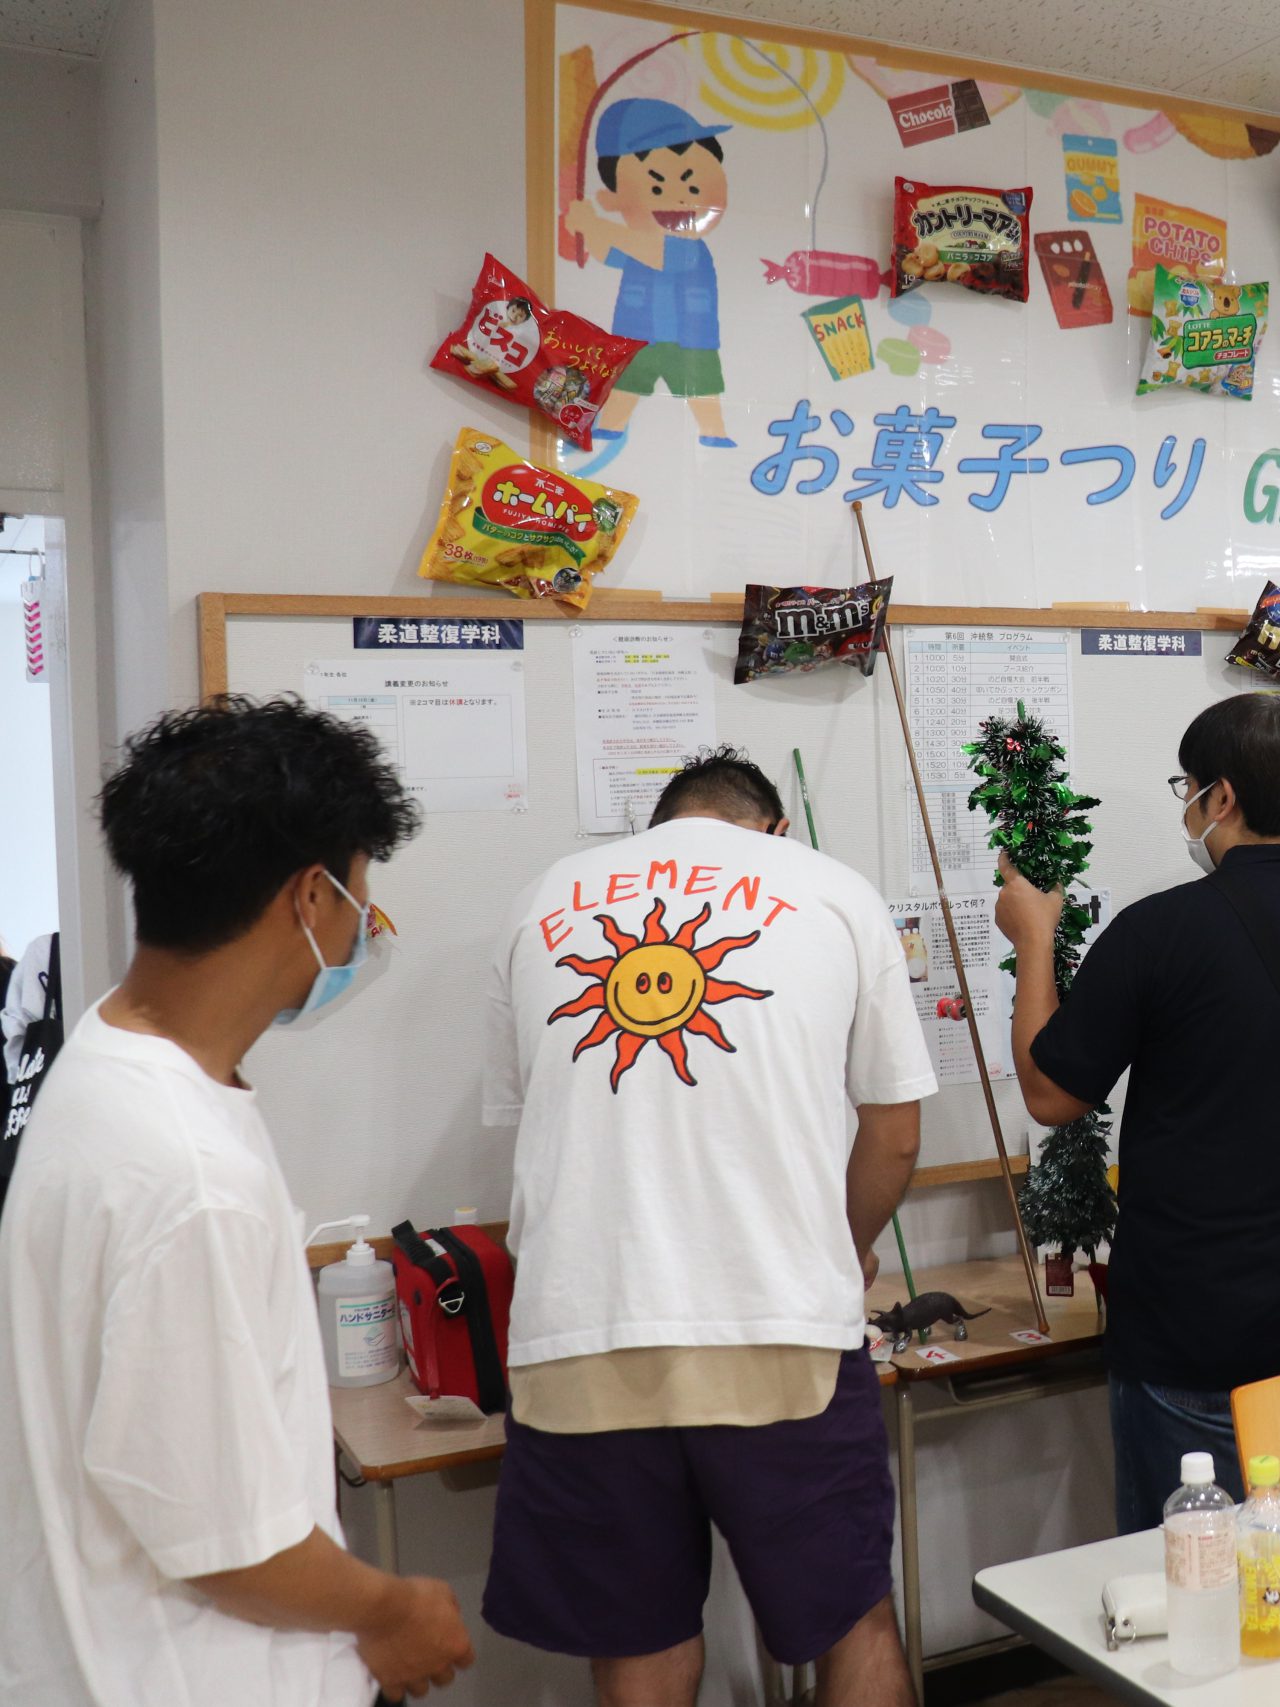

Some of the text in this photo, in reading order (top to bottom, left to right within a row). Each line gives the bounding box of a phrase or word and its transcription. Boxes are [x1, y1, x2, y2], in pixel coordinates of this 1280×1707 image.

[899, 102, 953, 128] Chocola
[1066, 157, 1117, 174] GUMMY
[1144, 216, 1221, 252] POTATO
[974, 253, 993, 262] ココア
[1149, 236, 1213, 266] CHIPS
[478, 307, 529, 368] ビスコ
[813, 312, 865, 343] SNACK
[1187, 322, 1211, 330] LOTTE
[1188, 325, 1253, 352] コアラのマーチ
[1216, 350, 1249, 360] チョコレート
[750, 400, 1207, 520] お菓子つり
[493, 481, 593, 533] ホームパイ
[444, 543, 473, 560] 38枚
[775, 600, 869, 639] m&m's
[378, 623, 501, 644] 柔道整復学科
[945, 632, 1033, 641] 第6回 沖統祭 プログラム
[1098, 633, 1186, 652] 柔道整復学科
[384, 680, 449, 688] 講義変更のお知らせ
[539, 858, 798, 952] ELEMENT
